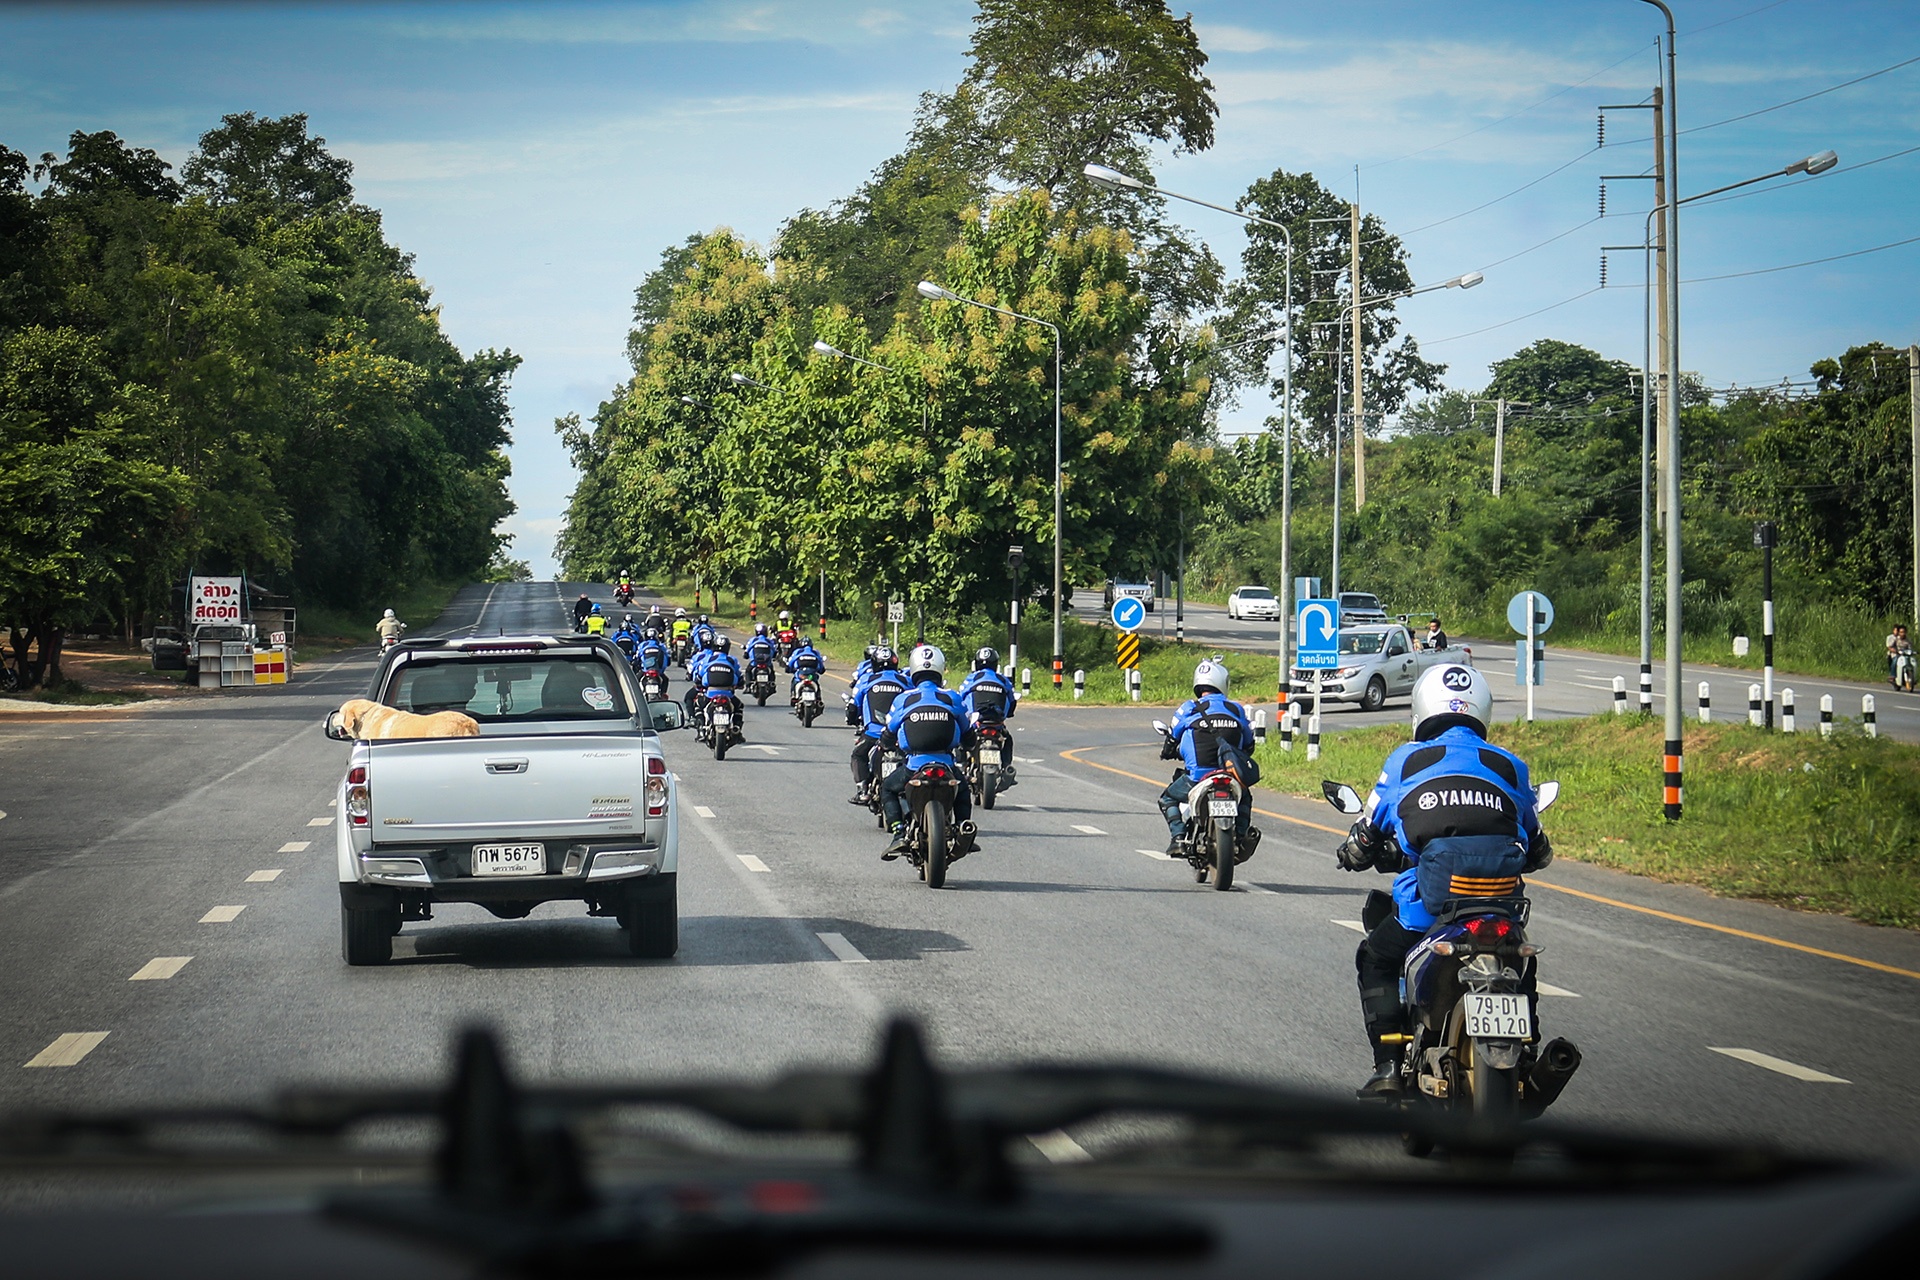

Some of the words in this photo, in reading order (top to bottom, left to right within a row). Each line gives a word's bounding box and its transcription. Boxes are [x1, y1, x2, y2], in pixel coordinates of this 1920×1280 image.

[203, 581, 231, 597] ล้าง
[272, 633, 285, 643] 100
[1301, 654, 1336, 666] จุดกลับรถ
[1445, 671, 1471, 687] 20
[919, 712, 949, 721] YAMAHA
[1438, 789, 1504, 812] YAMAHA
[504, 846, 539, 862] 5675
[1471, 1016, 1527, 1036] 361.20
